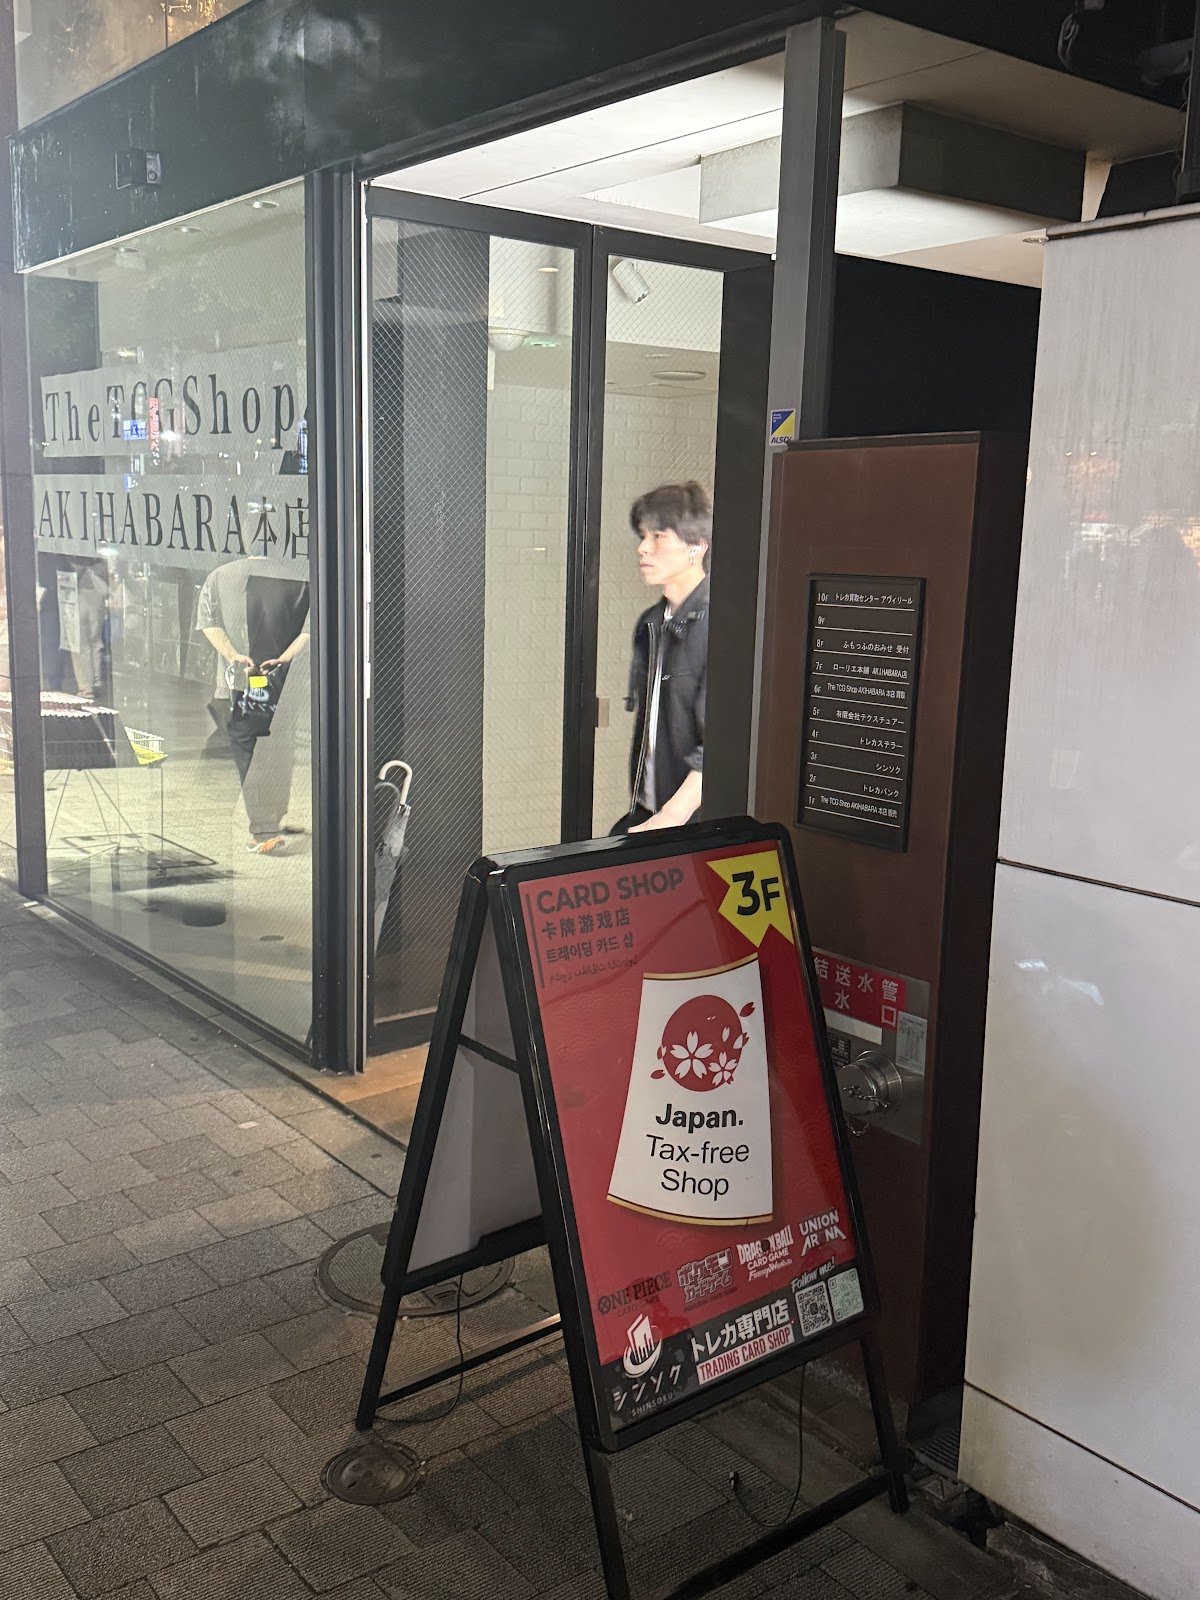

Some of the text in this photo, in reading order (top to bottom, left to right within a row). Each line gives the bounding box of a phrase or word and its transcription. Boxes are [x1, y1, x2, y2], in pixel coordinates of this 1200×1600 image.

[45, 390, 101, 442] The
[106, 378, 175, 439] TCG
[183, 374, 295, 449] Shop
[816, 639, 824, 648] 8F
[815, 661, 823, 671] 7F
[812, 707, 820, 716] 5F
[811, 729, 903, 750] 4F トレカステラー
[809, 773, 817, 783] 2F
[810, 751, 901, 775] 3F シンソク
[536, 867, 685, 915] CARD SHOP
[731, 870, 781, 917] 3F
[541, 907, 631, 941] 卡牌游戏店
[545, 940, 593, 963] 트레이딩
[597, 936, 621, 953] 카드
[655, 1103, 744, 1134] Japan.
[646, 1133, 750, 1164] Tax-free
[660, 1168, 730, 1201] Shop
[799, 1210, 840, 1236] UNION
[747, 1247, 789, 1272] CARD GAME
[791, 1255, 835, 1293] Follow me!
[597, 1287, 631, 1315] ONE
[632, 1271, 673, 1300] PIECE
[691, 1298, 790, 1363] トレカ専門店
[700, 1326, 791, 1381] TRADING CARD SHOP
[612, 1364, 682, 1411] シンソク
[631, 1391, 674, 1417] SHINSOKU
